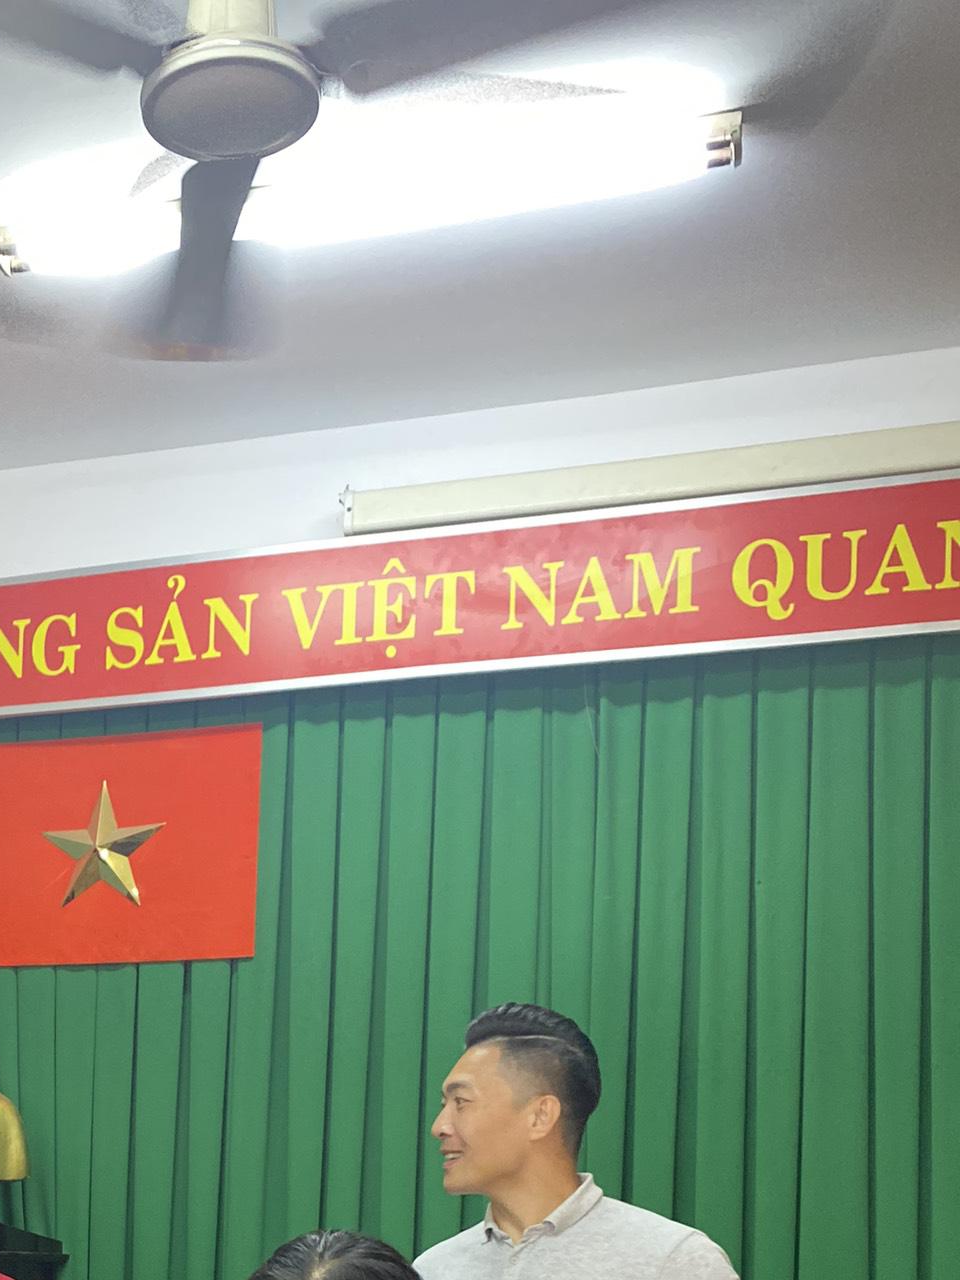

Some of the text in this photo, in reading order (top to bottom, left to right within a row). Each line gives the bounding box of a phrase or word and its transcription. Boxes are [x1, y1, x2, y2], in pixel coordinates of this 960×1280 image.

[105, 574, 260, 670] SẢN
[281, 556, 477, 659] VIỆT
[501, 546, 702, 630] NAM
